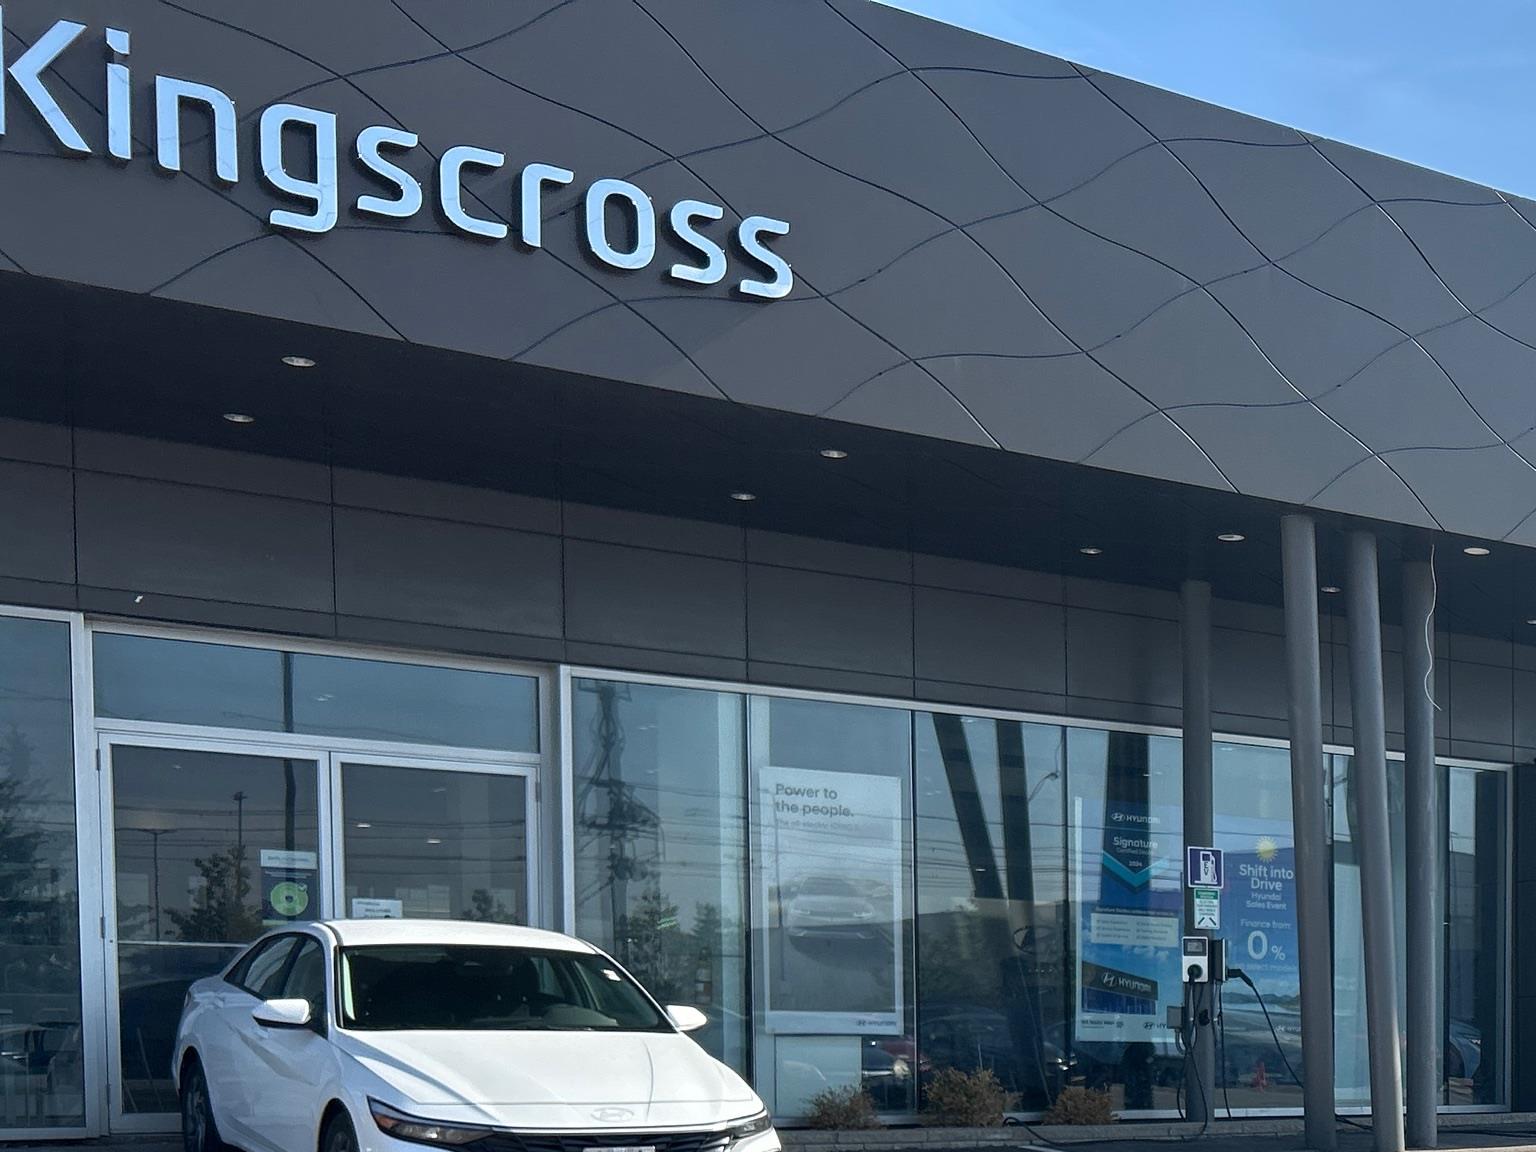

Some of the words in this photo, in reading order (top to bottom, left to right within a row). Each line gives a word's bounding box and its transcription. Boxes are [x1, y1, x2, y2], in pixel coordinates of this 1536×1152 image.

[0, 6, 796, 300] Kingscross
[775, 783, 820, 798] Power
[823, 788, 838, 800] to
[775, 800, 799, 814] the
[802, 804, 854, 818] people.
[1112, 836, 1159, 849] Signature
[1203, 861, 1209, 876] EV
[1239, 864, 1268, 878] Shift
[1270, 865, 1294, 880] into
[1251, 877, 1282, 891] Drive
[1251, 892, 1282, 901] Hyundai
[1240, 918, 1271, 929] Finance
